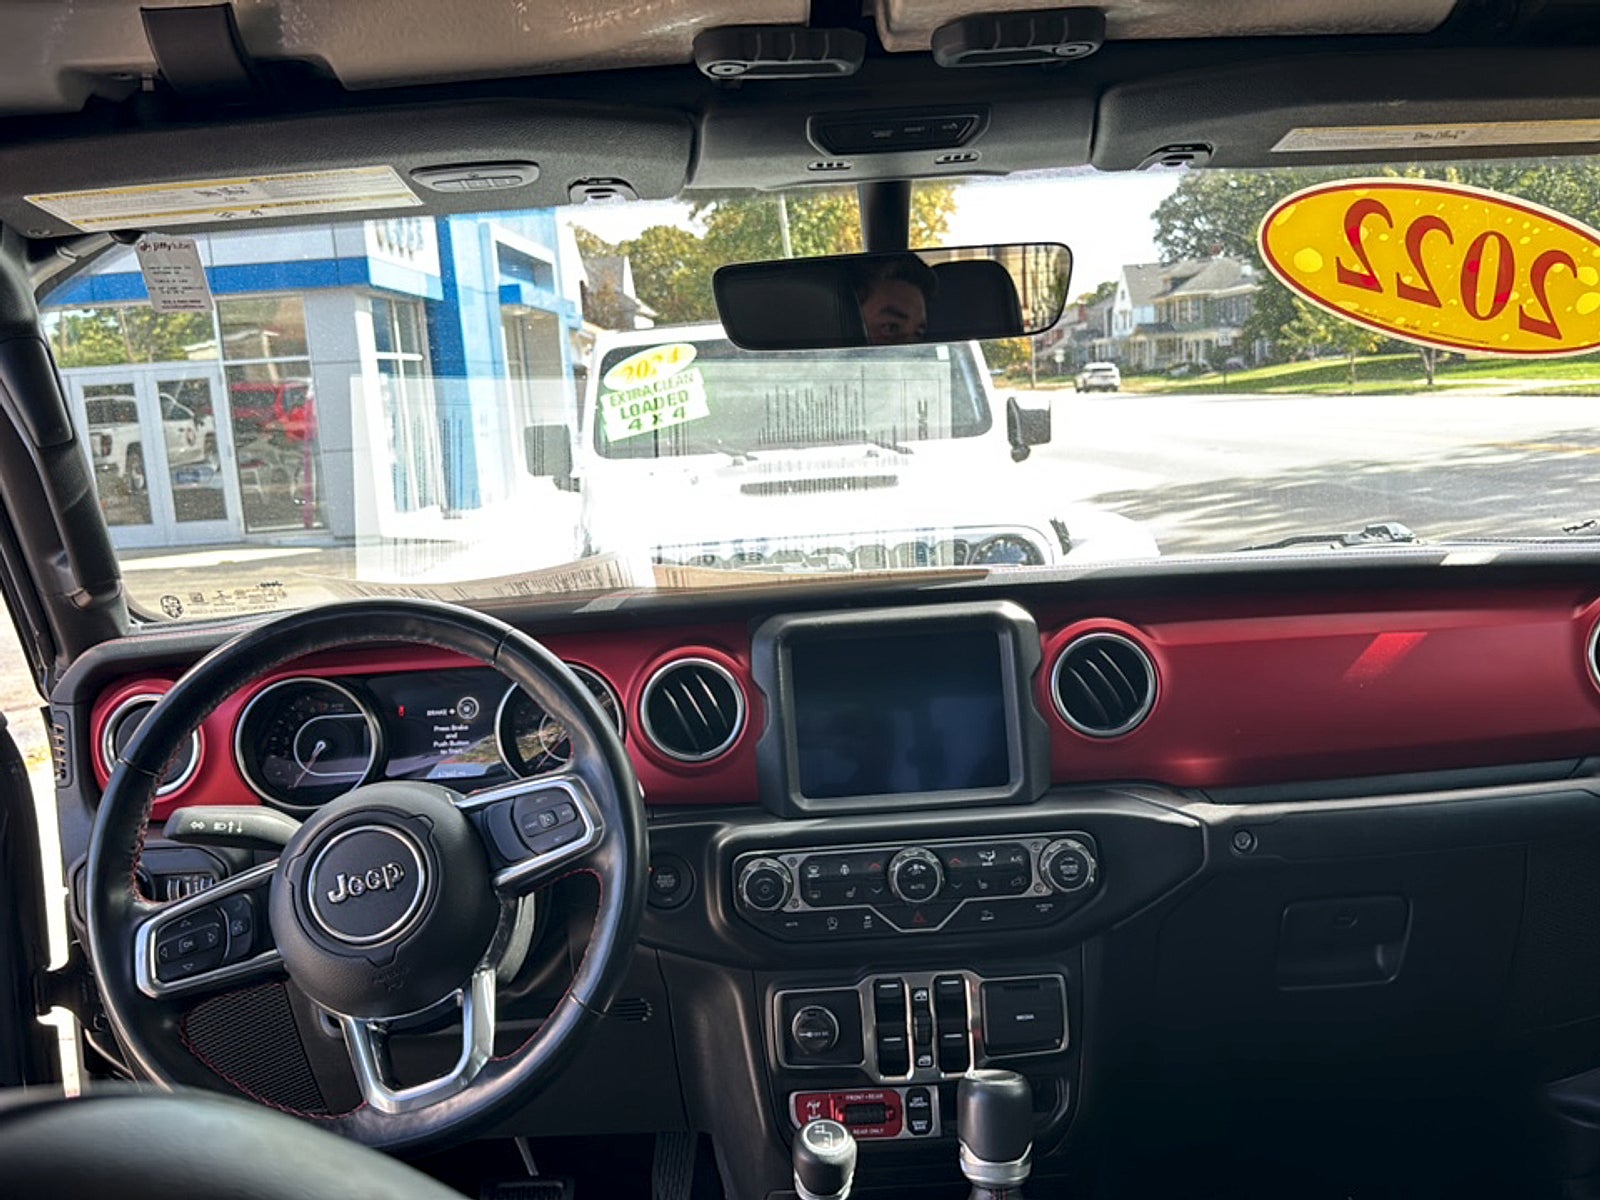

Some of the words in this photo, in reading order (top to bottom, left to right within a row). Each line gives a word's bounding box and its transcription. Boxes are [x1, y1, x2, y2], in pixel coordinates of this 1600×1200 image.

[620, 390, 689, 420] LOADED
[628, 418, 642, 430] 4
[327, 867, 403, 903] Jeep
